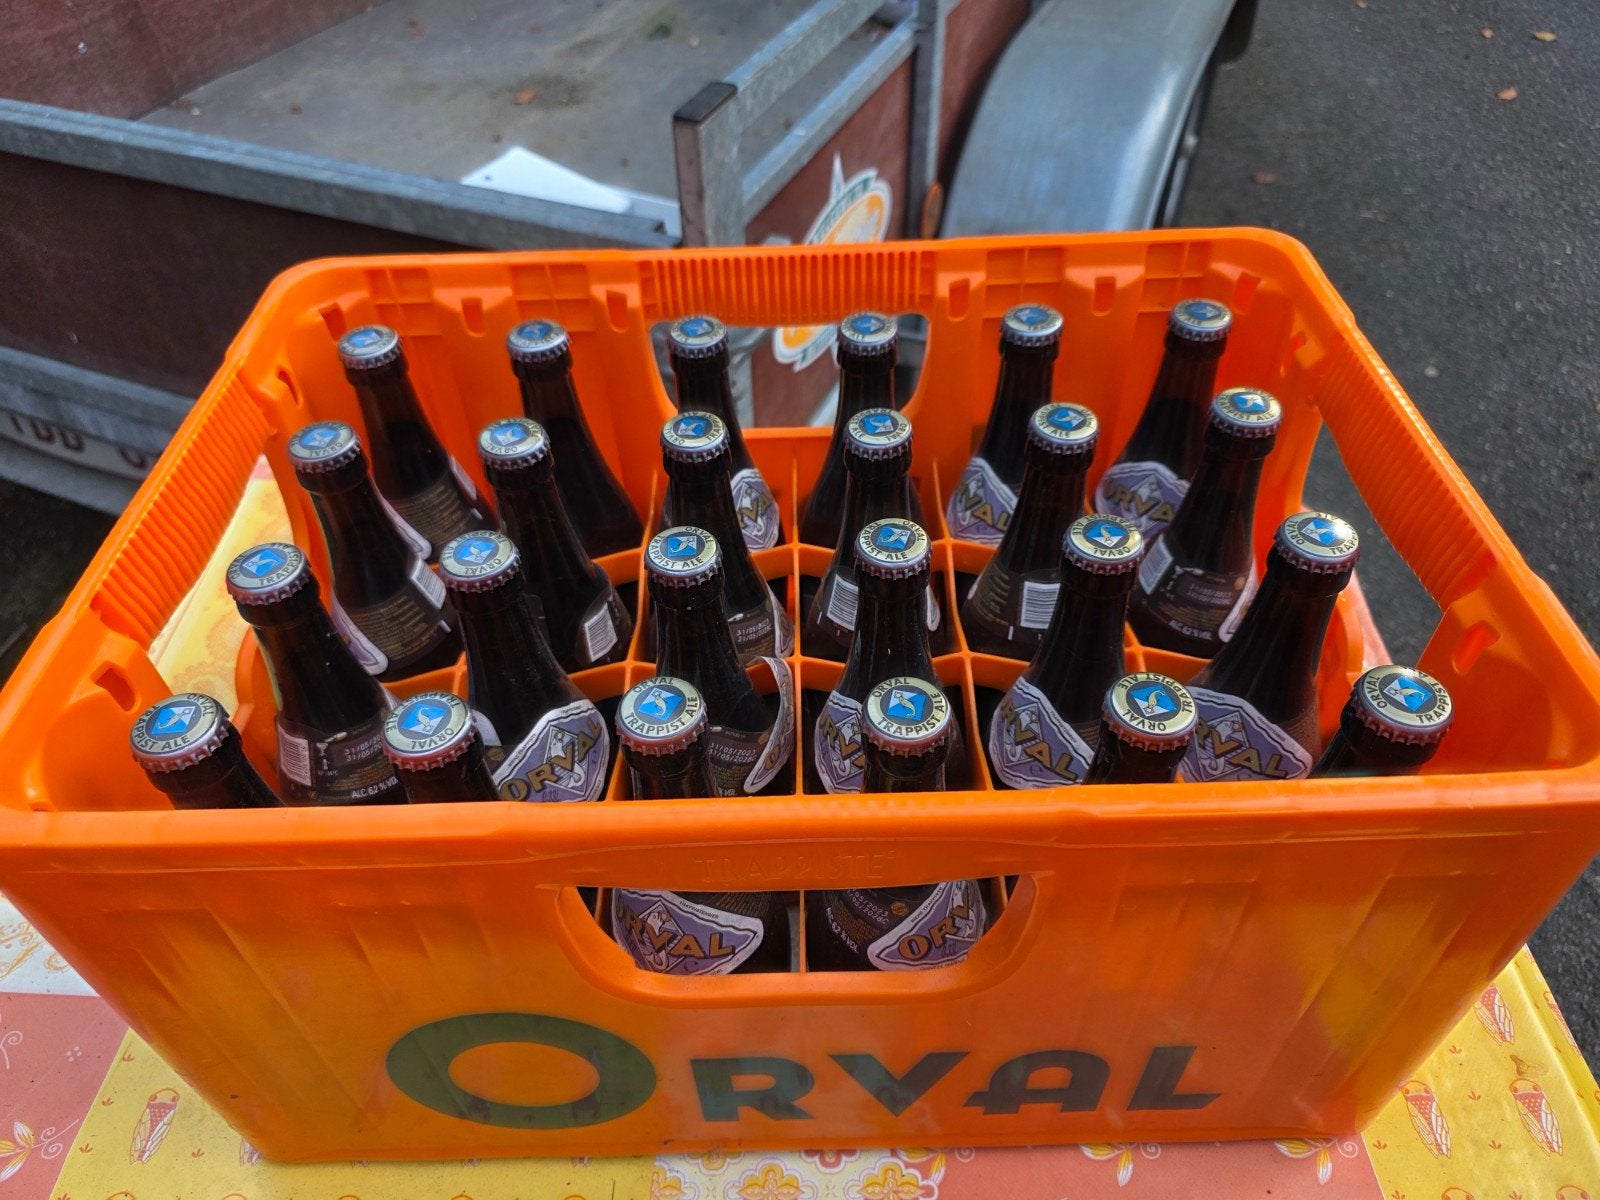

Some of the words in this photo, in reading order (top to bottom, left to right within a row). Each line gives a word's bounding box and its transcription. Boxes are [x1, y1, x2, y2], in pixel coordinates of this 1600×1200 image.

[1257, 411, 1274, 421] ALE
[1050, 428, 1070, 438] ALE
[685, 526, 714, 543] ORVAL
[861, 522, 882, 557] TRAPPIST
[885, 552, 908, 560] ALE
[902, 520, 926, 542] ORVAL
[1286, 519, 1305, 545] ORVAL
[649, 535, 677, 569] TRAPPIST
[682, 556, 704, 569] ALE
[1093, 546, 1131, 557] ORVAL
[258, 549, 299, 585] TRAPPIST
[464, 558, 502, 575] ORVAL
[633, 677, 674, 694] ORVAL
[872, 677, 911, 698] ORVAL
[1118, 674, 1139, 690] ALE
[1145, 673, 1193, 713] TRAPPIST
[1366, 675, 1387, 708] ORVAL
[186, 693, 214, 717] ORVAL
[877, 714, 941, 736] TRAPPIST
[930, 692, 945, 713] ALE
[1416, 682, 1450, 724] TRAPPIST
[624, 711, 686, 735] TRAPPIST
[685, 696, 698, 718] ALE
[1123, 708, 1167, 732] ORVAL
[161, 734, 191, 752] ALE
[411, 727, 455, 750] ORVAL
[386, 1013, 1222, 1129] ORVAL
